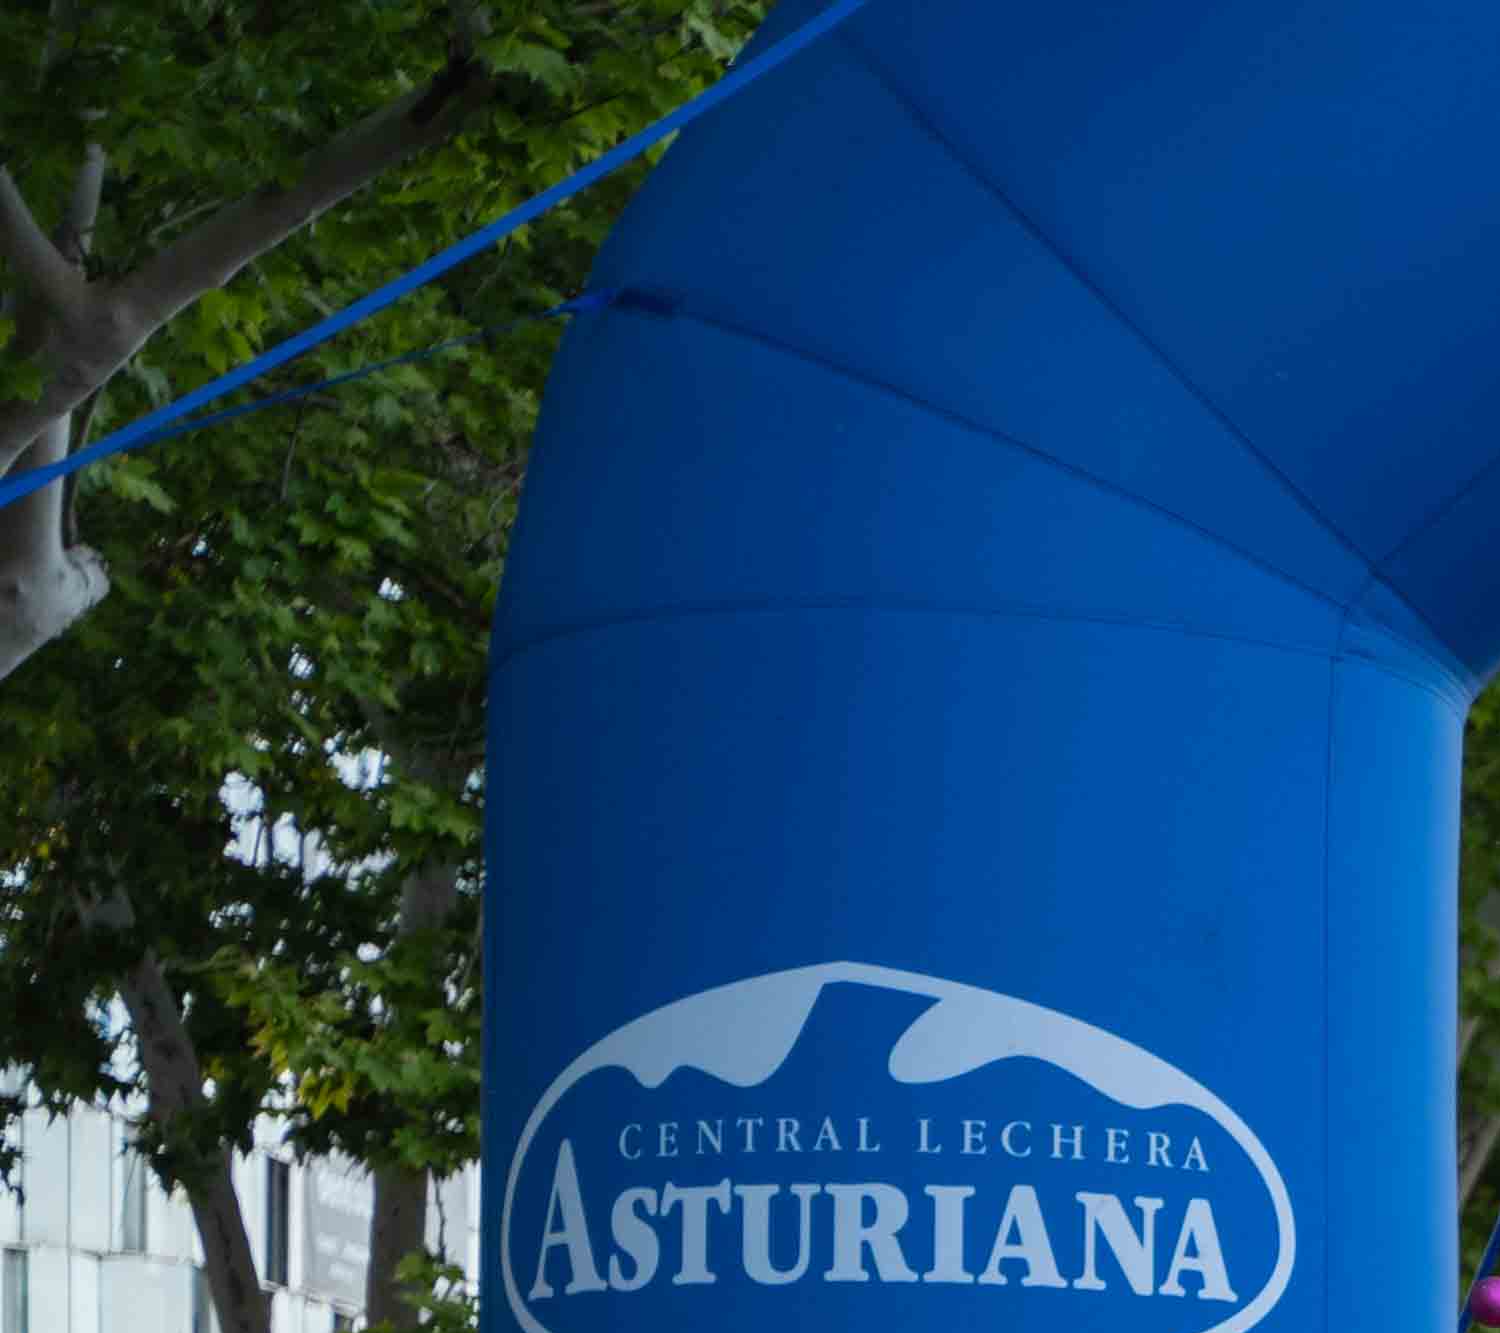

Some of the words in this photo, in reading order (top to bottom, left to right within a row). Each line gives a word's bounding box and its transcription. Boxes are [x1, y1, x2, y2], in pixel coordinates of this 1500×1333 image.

[618, 1115, 881, 1160] CENTRAL
[916, 1117, 1209, 1172] LECHERA
[527, 1137, 1239, 1304] ASTURIANA
